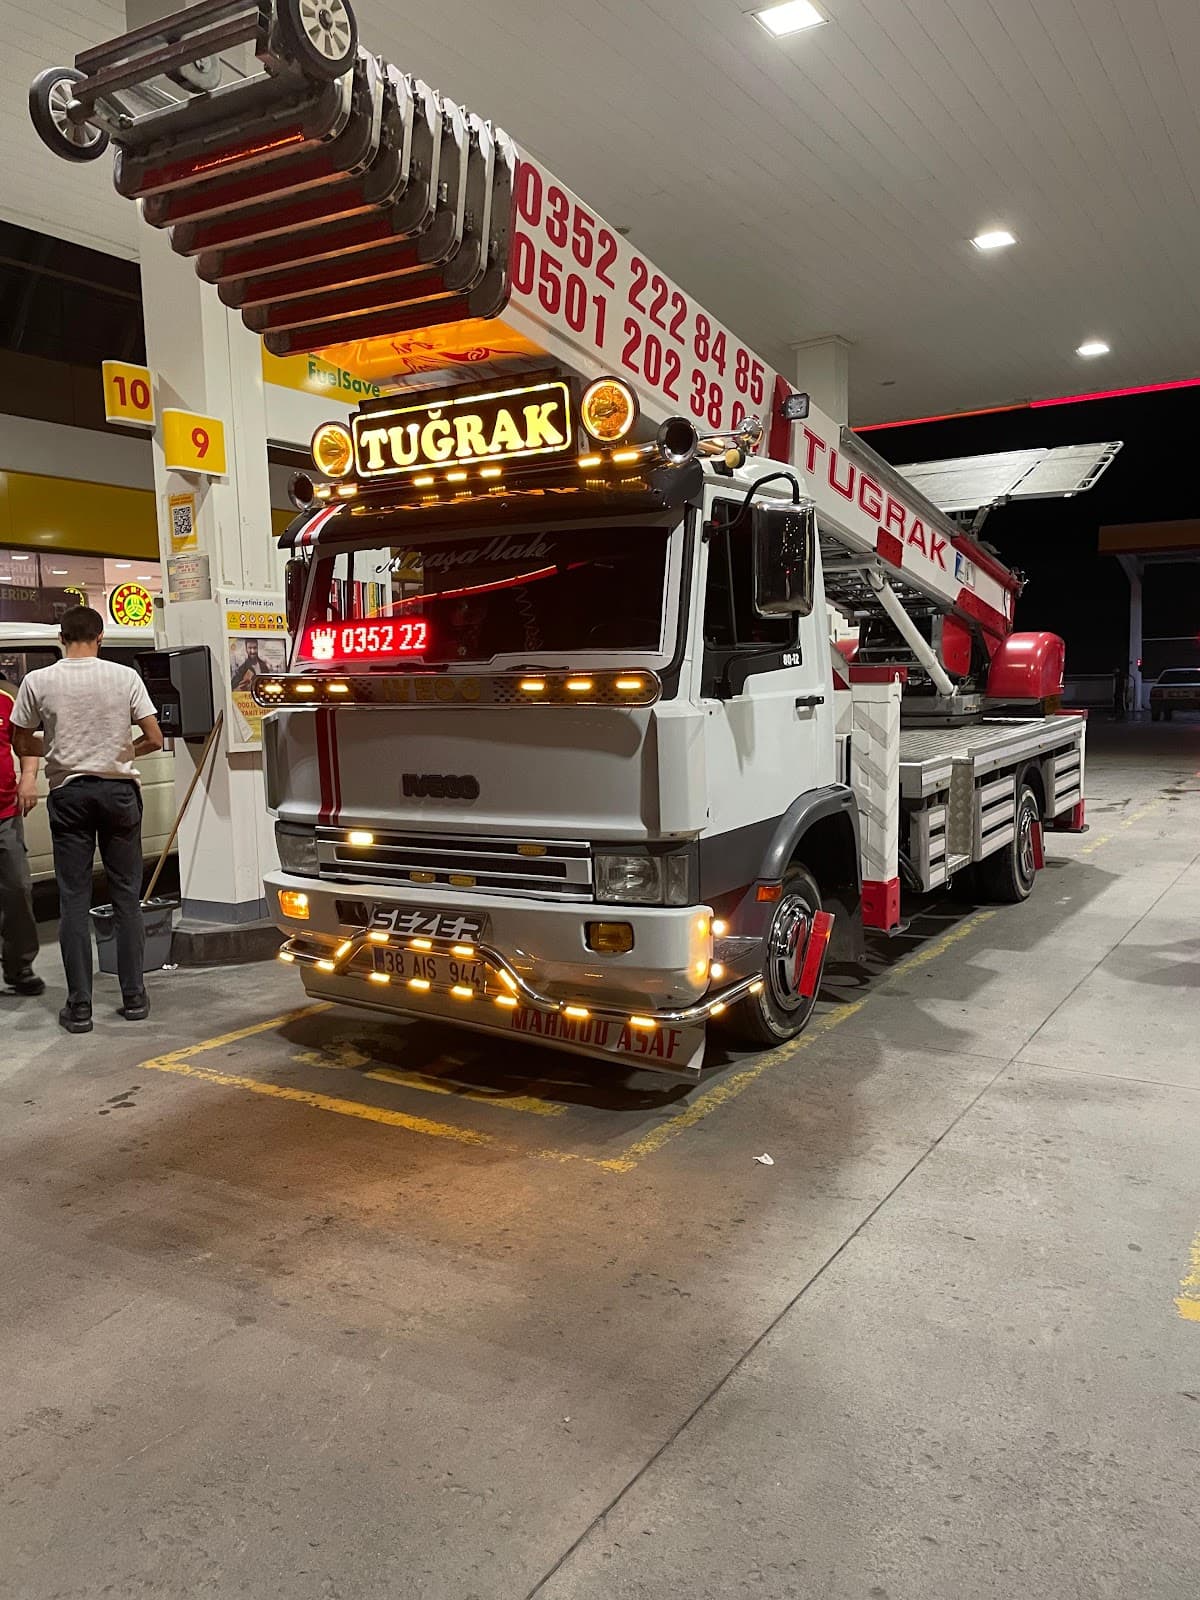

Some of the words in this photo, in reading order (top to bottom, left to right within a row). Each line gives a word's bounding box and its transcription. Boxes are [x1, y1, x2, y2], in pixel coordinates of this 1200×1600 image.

[517, 162, 617, 290] 0352
[628, 257, 688, 345] 222
[694, 314, 727, 376] 84
[735, 348, 765, 405] 85
[511, 232, 607, 348] 0501
[622, 317, 681, 402] 202
[690, 369, 723, 429] 38
[113, 376, 150, 410] 10
[308, 361, 380, 398] FuelSave
[191, 427, 210, 459] 9
[360, 401, 564, 470] TUĞRAK
[225, 598, 262, 606] Emniyetiniz
[341, 625, 394, 653] 0352
[400, 623, 426, 650] 22
[369, 908, 481, 941] SEZER
[384, 951, 405, 974] 38
[412, 955, 437, 979] AIS
[449, 962, 481, 986] 944
[616, 1023, 682, 1059] ASAF
